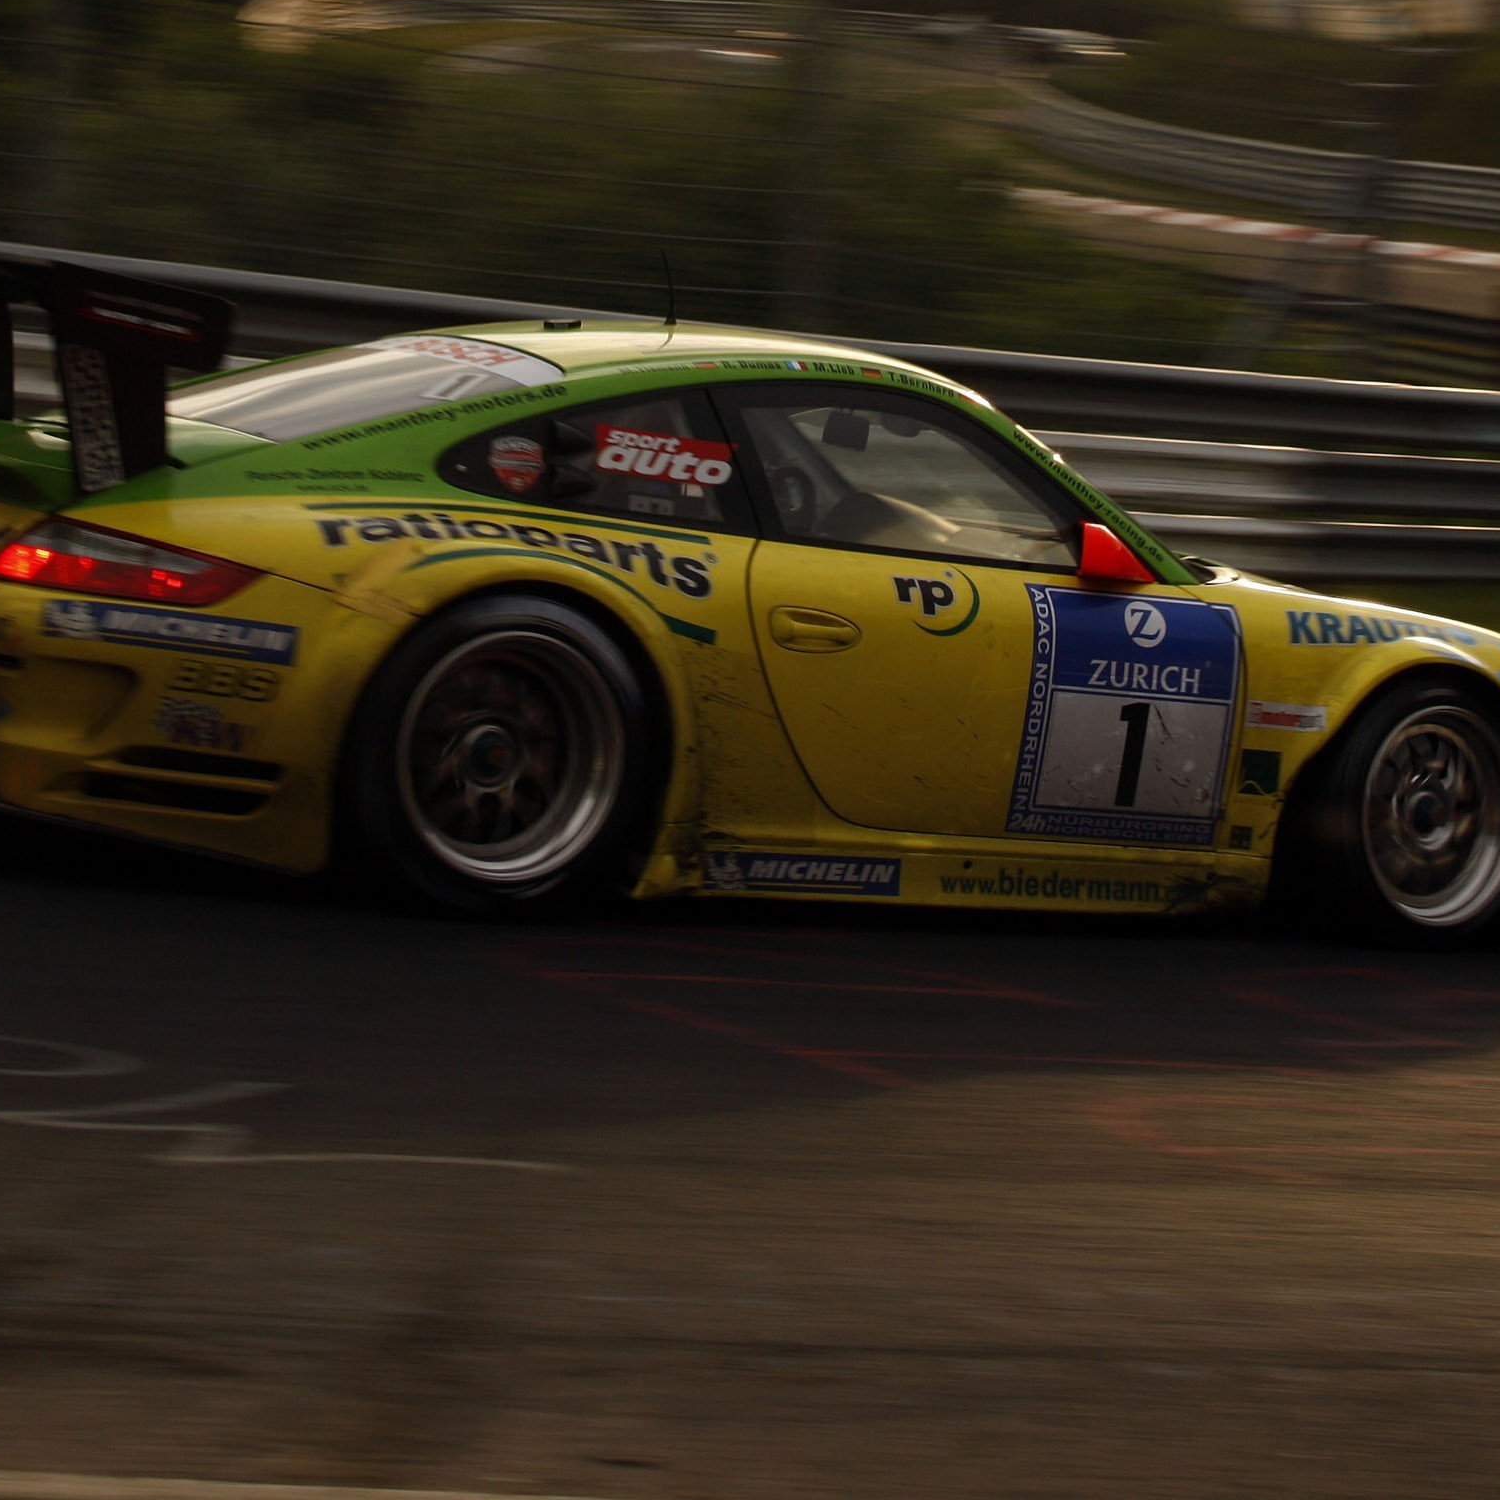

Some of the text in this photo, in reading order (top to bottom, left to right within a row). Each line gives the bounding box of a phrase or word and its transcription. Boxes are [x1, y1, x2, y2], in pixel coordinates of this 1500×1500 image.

[419, 371, 491, 401] 1
[300, 383, 569, 451] www.manthey-motors.de
[604, 428, 682, 453] sport
[596, 444, 733, 486] auto
[1012, 430, 1166, 563] www.manthey-racing.de
[315, 511, 714, 598] ratioparts
[891, 575, 955, 616] rp
[100, 608, 296, 651] MICHELIN
[165, 657, 281, 703] BBS
[1087, 658, 1201, 695] ZURICH
[1012, 586, 1051, 812] ADAC NORDRHEIN
[1113, 702, 1151, 808] 1
[1009, 812, 1046, 834] 24h
[750, 859, 897, 884] MICHELIN
